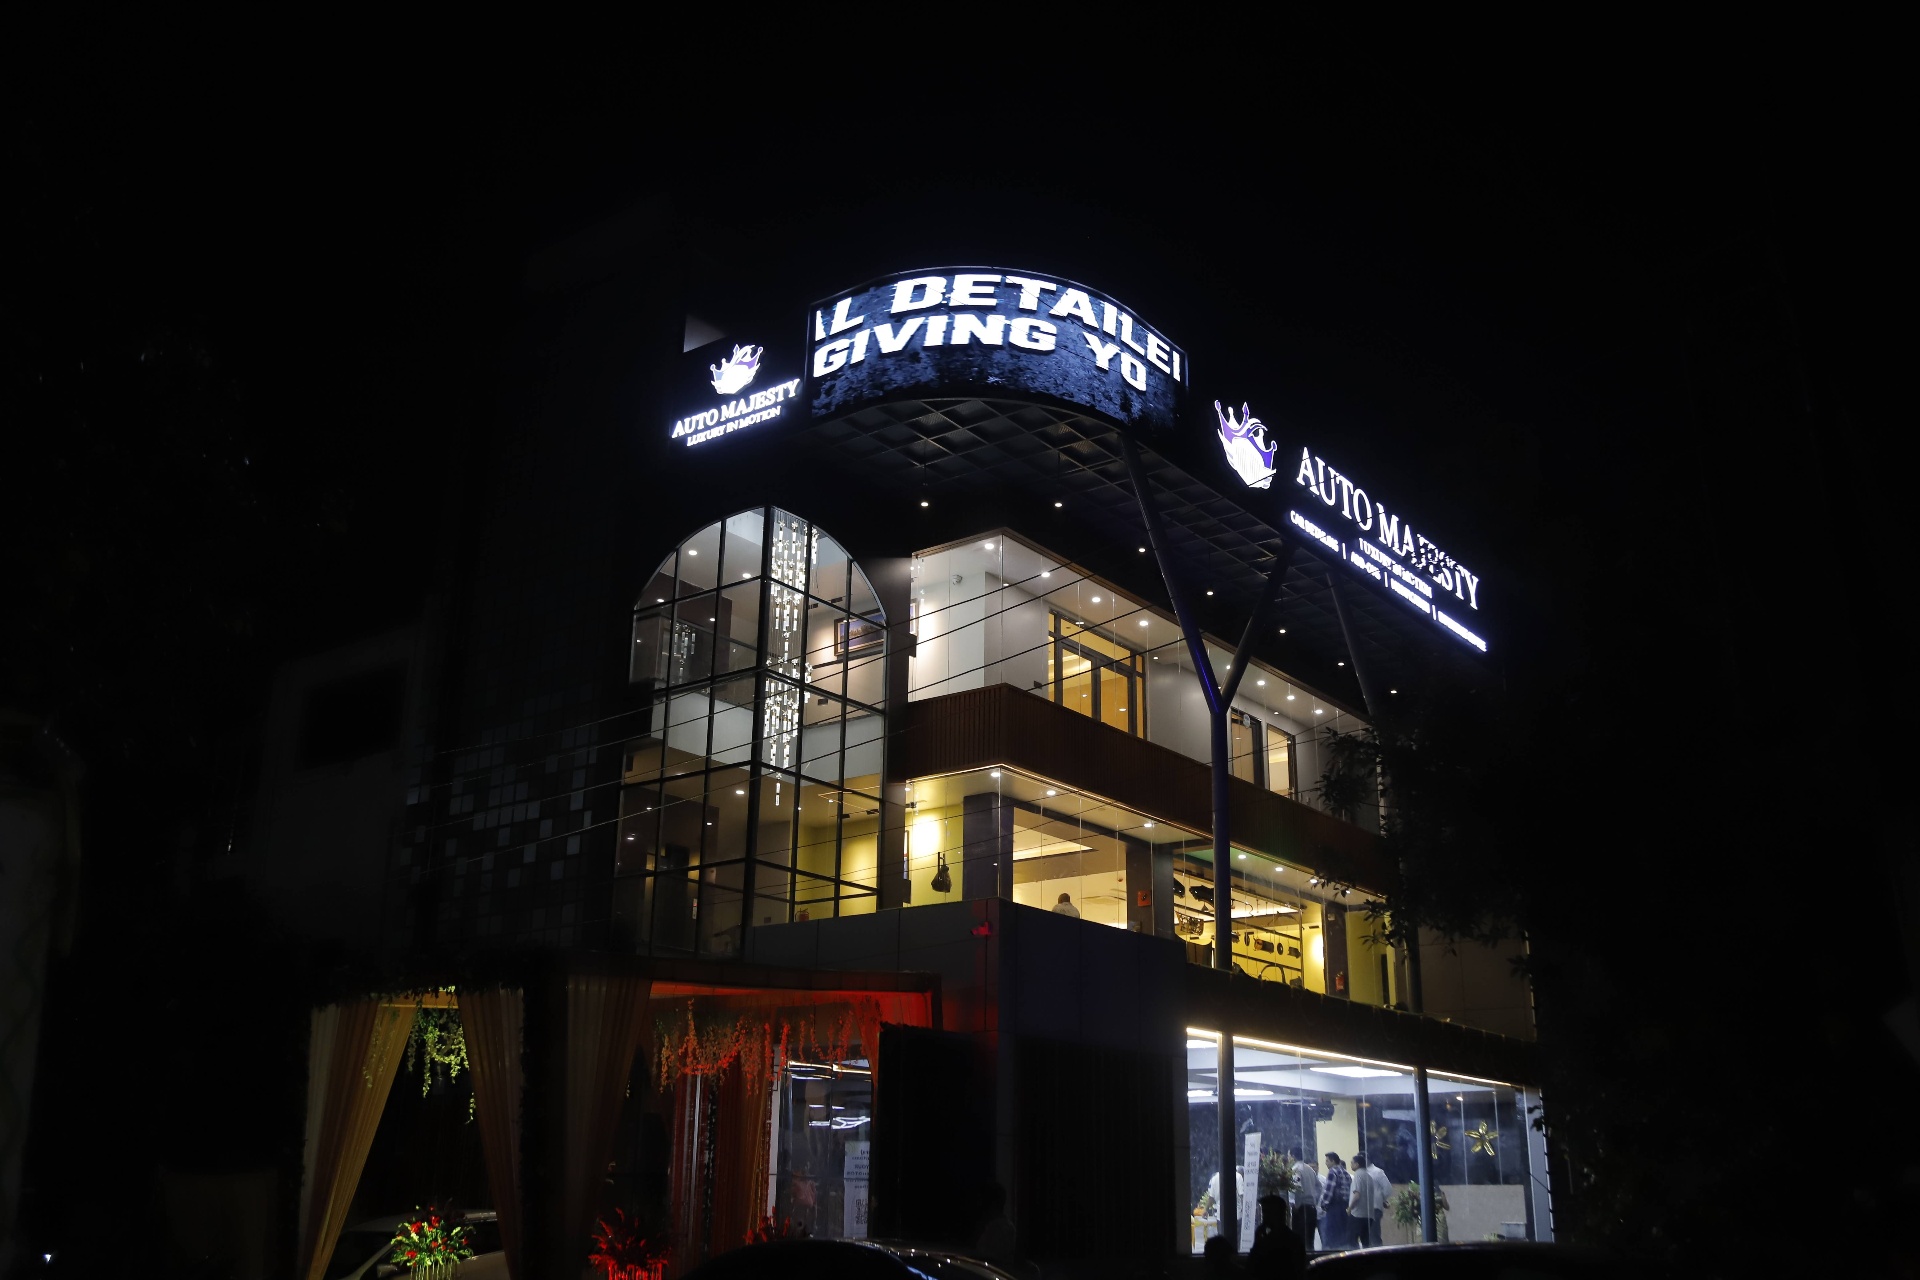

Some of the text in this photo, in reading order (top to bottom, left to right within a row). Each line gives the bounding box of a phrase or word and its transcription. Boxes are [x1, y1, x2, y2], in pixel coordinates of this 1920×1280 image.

[813, 314, 1147, 392] GIVING YO
[890, 274, 1181, 382] DETAILE
[672, 378, 800, 438] AUTO MAJESTY
[686, 406, 781, 446] LUXURY IN MOTION
[1296, 446, 1373, 531] AUTO
